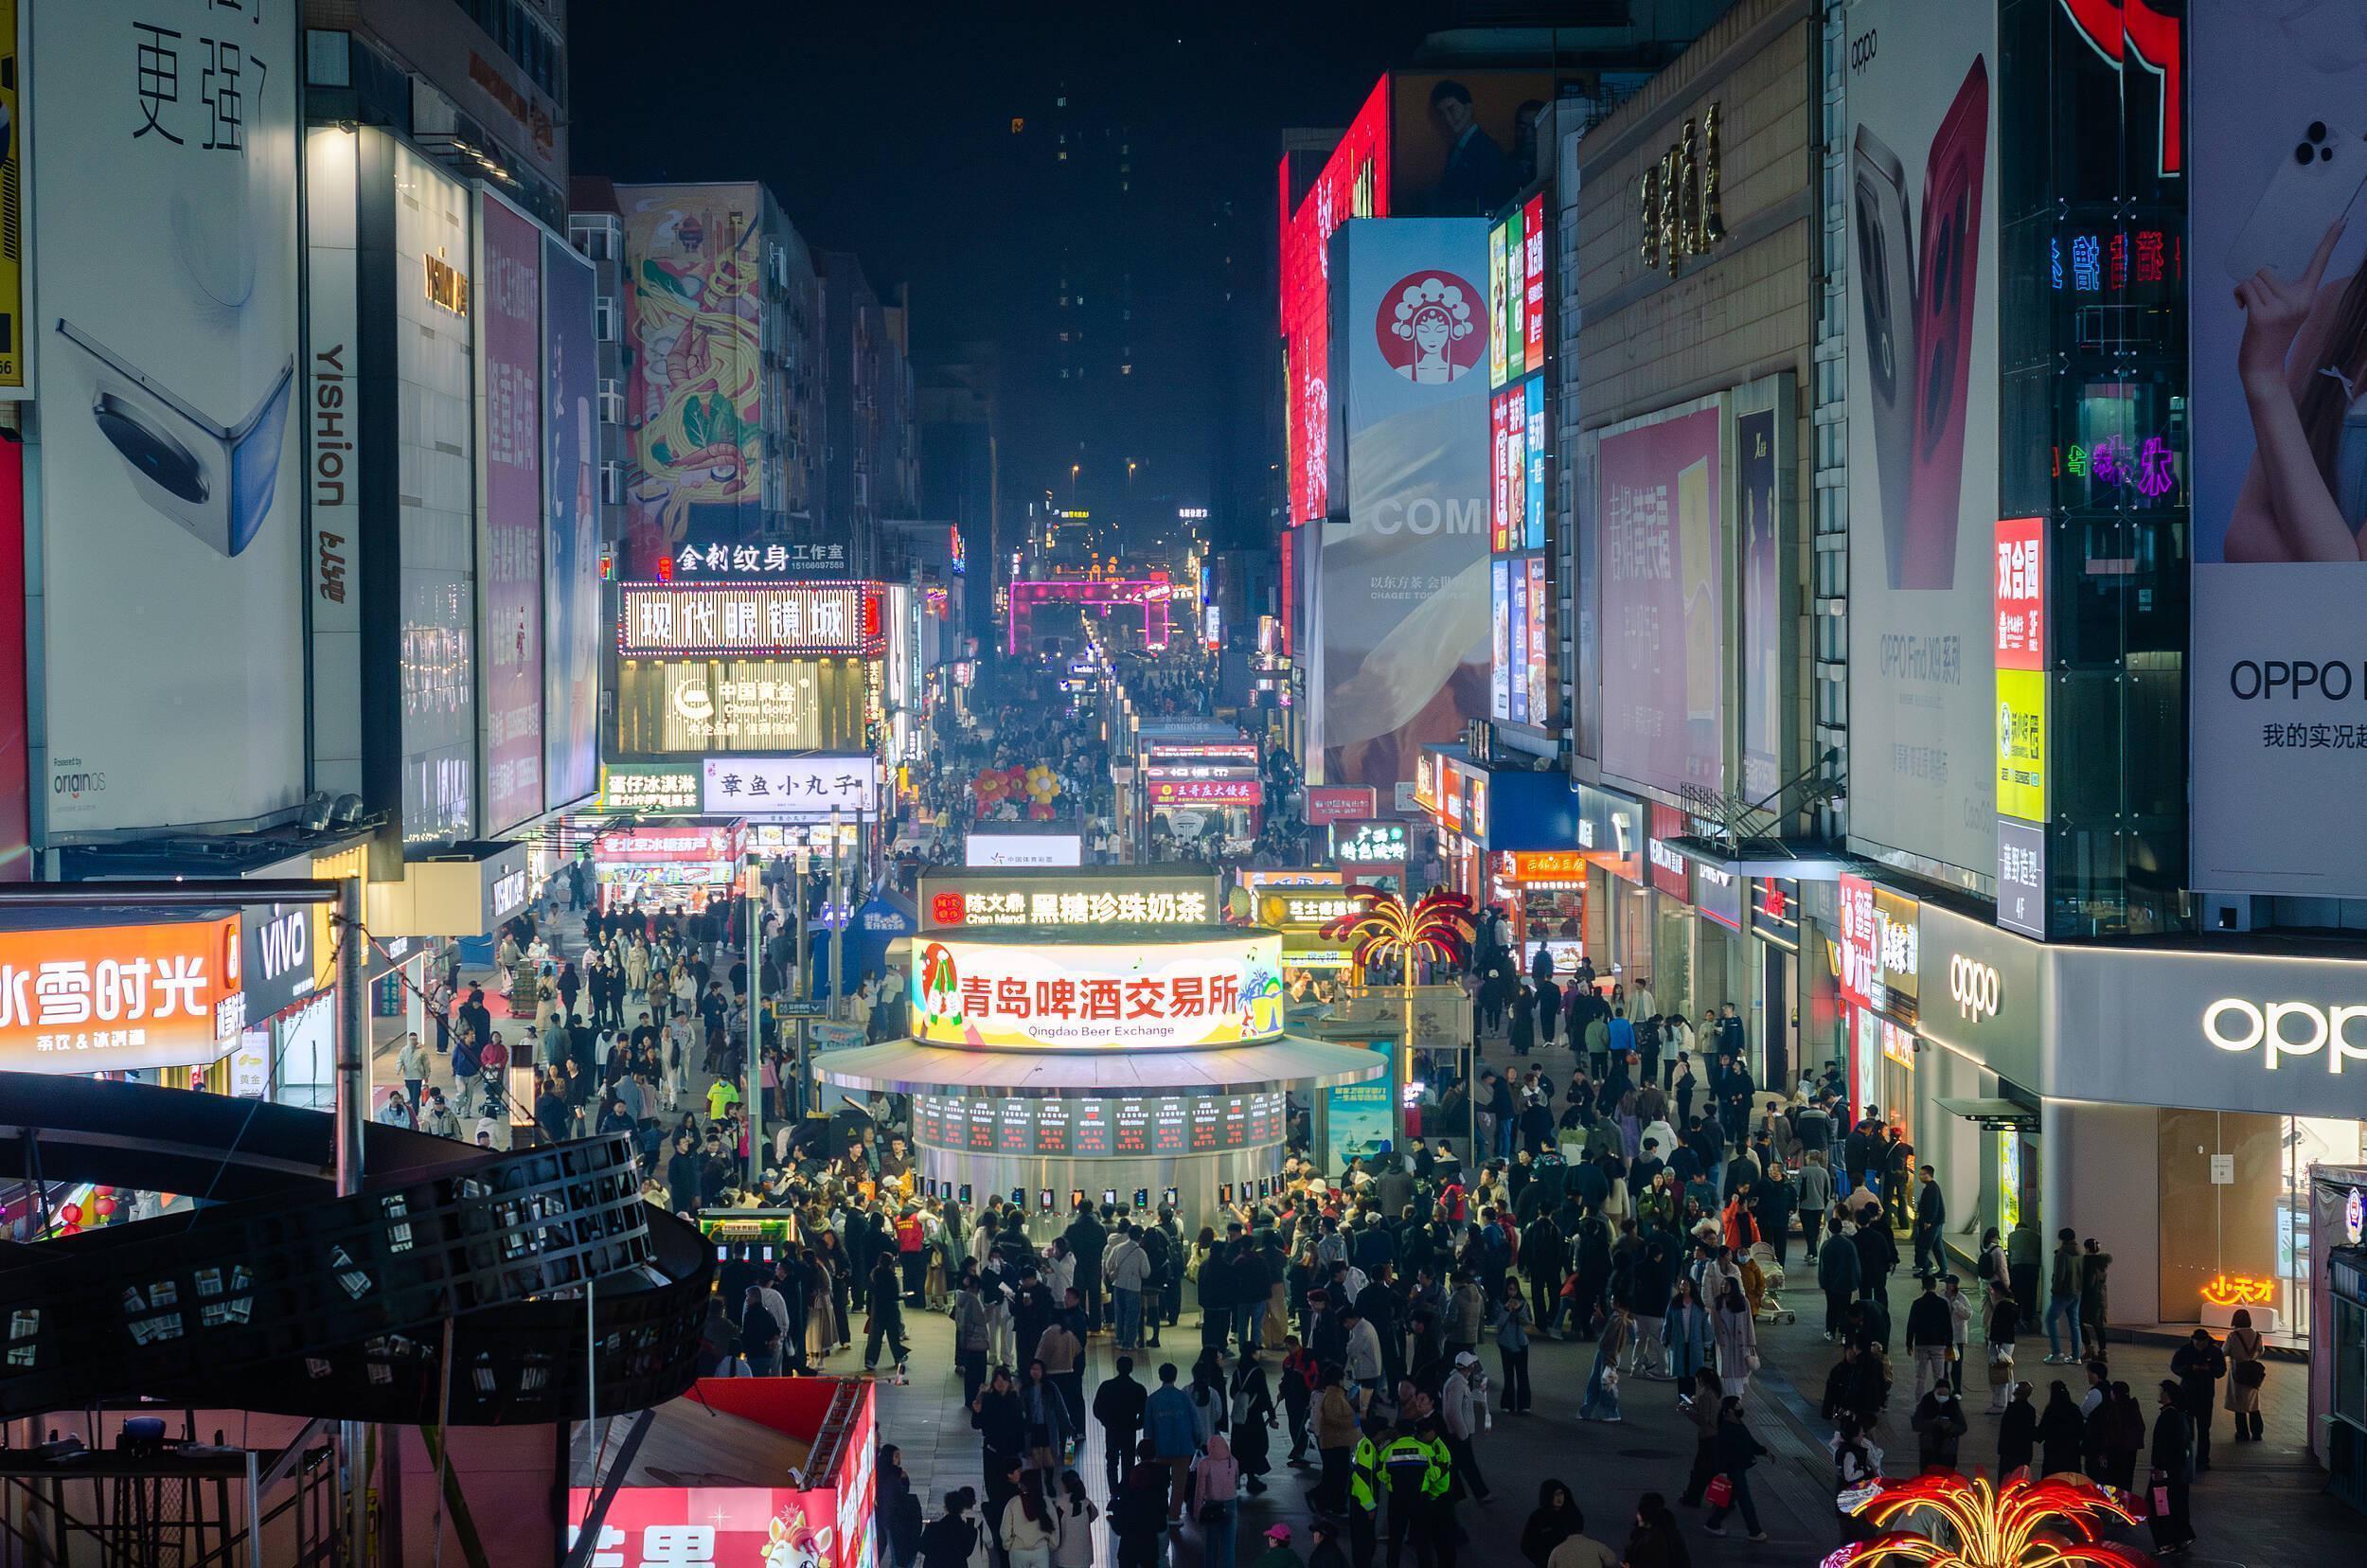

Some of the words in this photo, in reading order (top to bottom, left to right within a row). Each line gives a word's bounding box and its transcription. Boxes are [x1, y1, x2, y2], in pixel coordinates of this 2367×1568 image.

[1852, 28, 1878, 75] oppo
[1373, 498, 1490, 535] COM
[676, 543, 790, 572] 金刺纹身
[792, 543, 845, 561] 工作室
[641, 600, 843, 639] 现代眼镜城
[719, 682, 795, 703] 中国黄金
[2231, 660, 2352, 701] OPPO
[609, 775, 696, 794] 蛋仔冰淇淋
[721, 775, 857, 797] 章鱼小丸子
[604, 837, 708, 854] 老北京冰糖葫芦
[966, 894, 1026, 914] 陈文鼎
[1030, 893, 1206, 924] 黑糖珍珠奶茶
[2015, 898, 2026, 919] 4F
[960, 971, 1240, 1022] 青岛啤酒交易所
[1950, 953, 2001, 1023] oppo
[36, 1034, 71, 1051] 茶饮
[1028, 1025, 1078, 1039] Qingdao
[1081, 1025, 1111, 1037] Beer
[1115, 1025, 1175, 1039] Exchange
[240, 1074, 261, 1084] 黄金
[2211, 1274, 2274, 1306] 小天才
